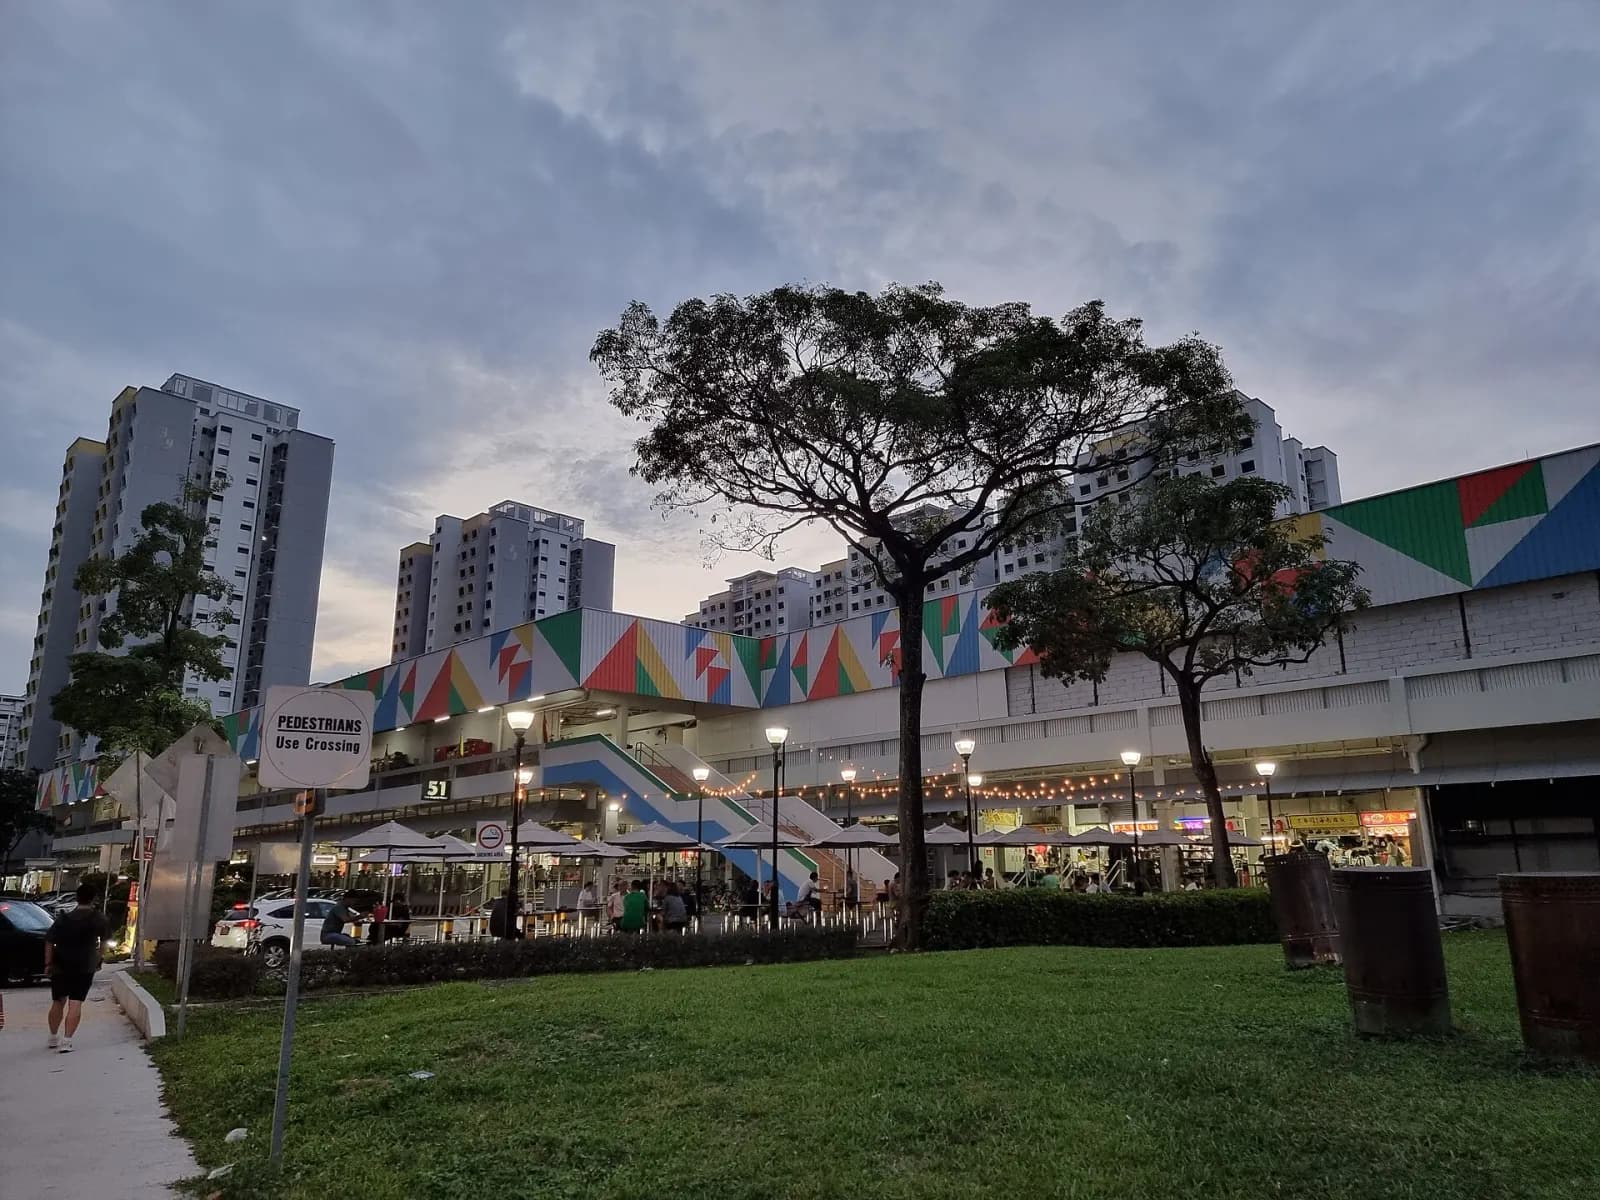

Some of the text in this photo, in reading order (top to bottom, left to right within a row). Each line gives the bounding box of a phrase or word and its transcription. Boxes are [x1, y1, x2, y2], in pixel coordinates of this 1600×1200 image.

[278, 715, 362, 733] PEDESTRIANS
[276, 736, 360, 754] Use Crossing
[427, 780, 447, 796] 51
